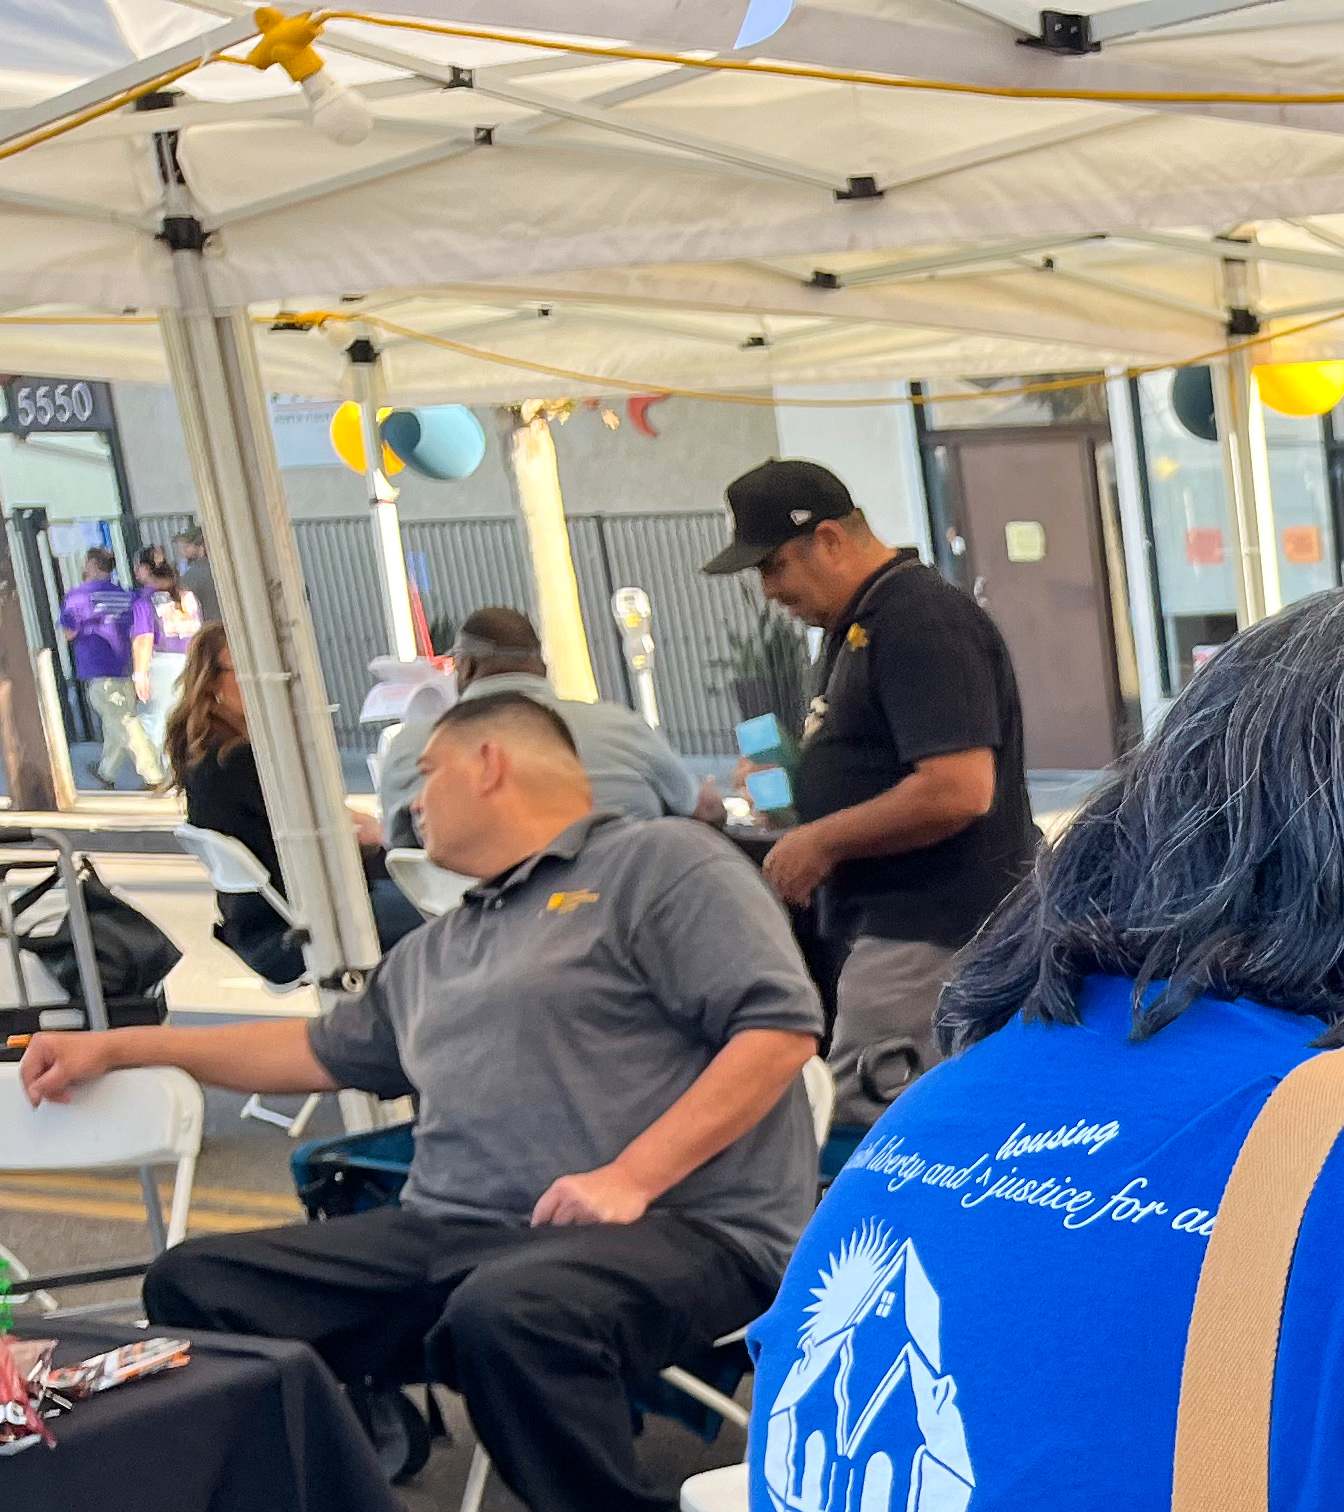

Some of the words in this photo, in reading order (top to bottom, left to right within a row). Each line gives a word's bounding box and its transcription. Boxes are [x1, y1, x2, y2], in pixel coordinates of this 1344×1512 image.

[17, 382, 93, 427] 5550
[996, 1119, 1119, 1161] housing
[921, 1153, 990, 1190] and
[961, 1167, 1095, 1212] justice
[1063, 1177, 1168, 1229] for
